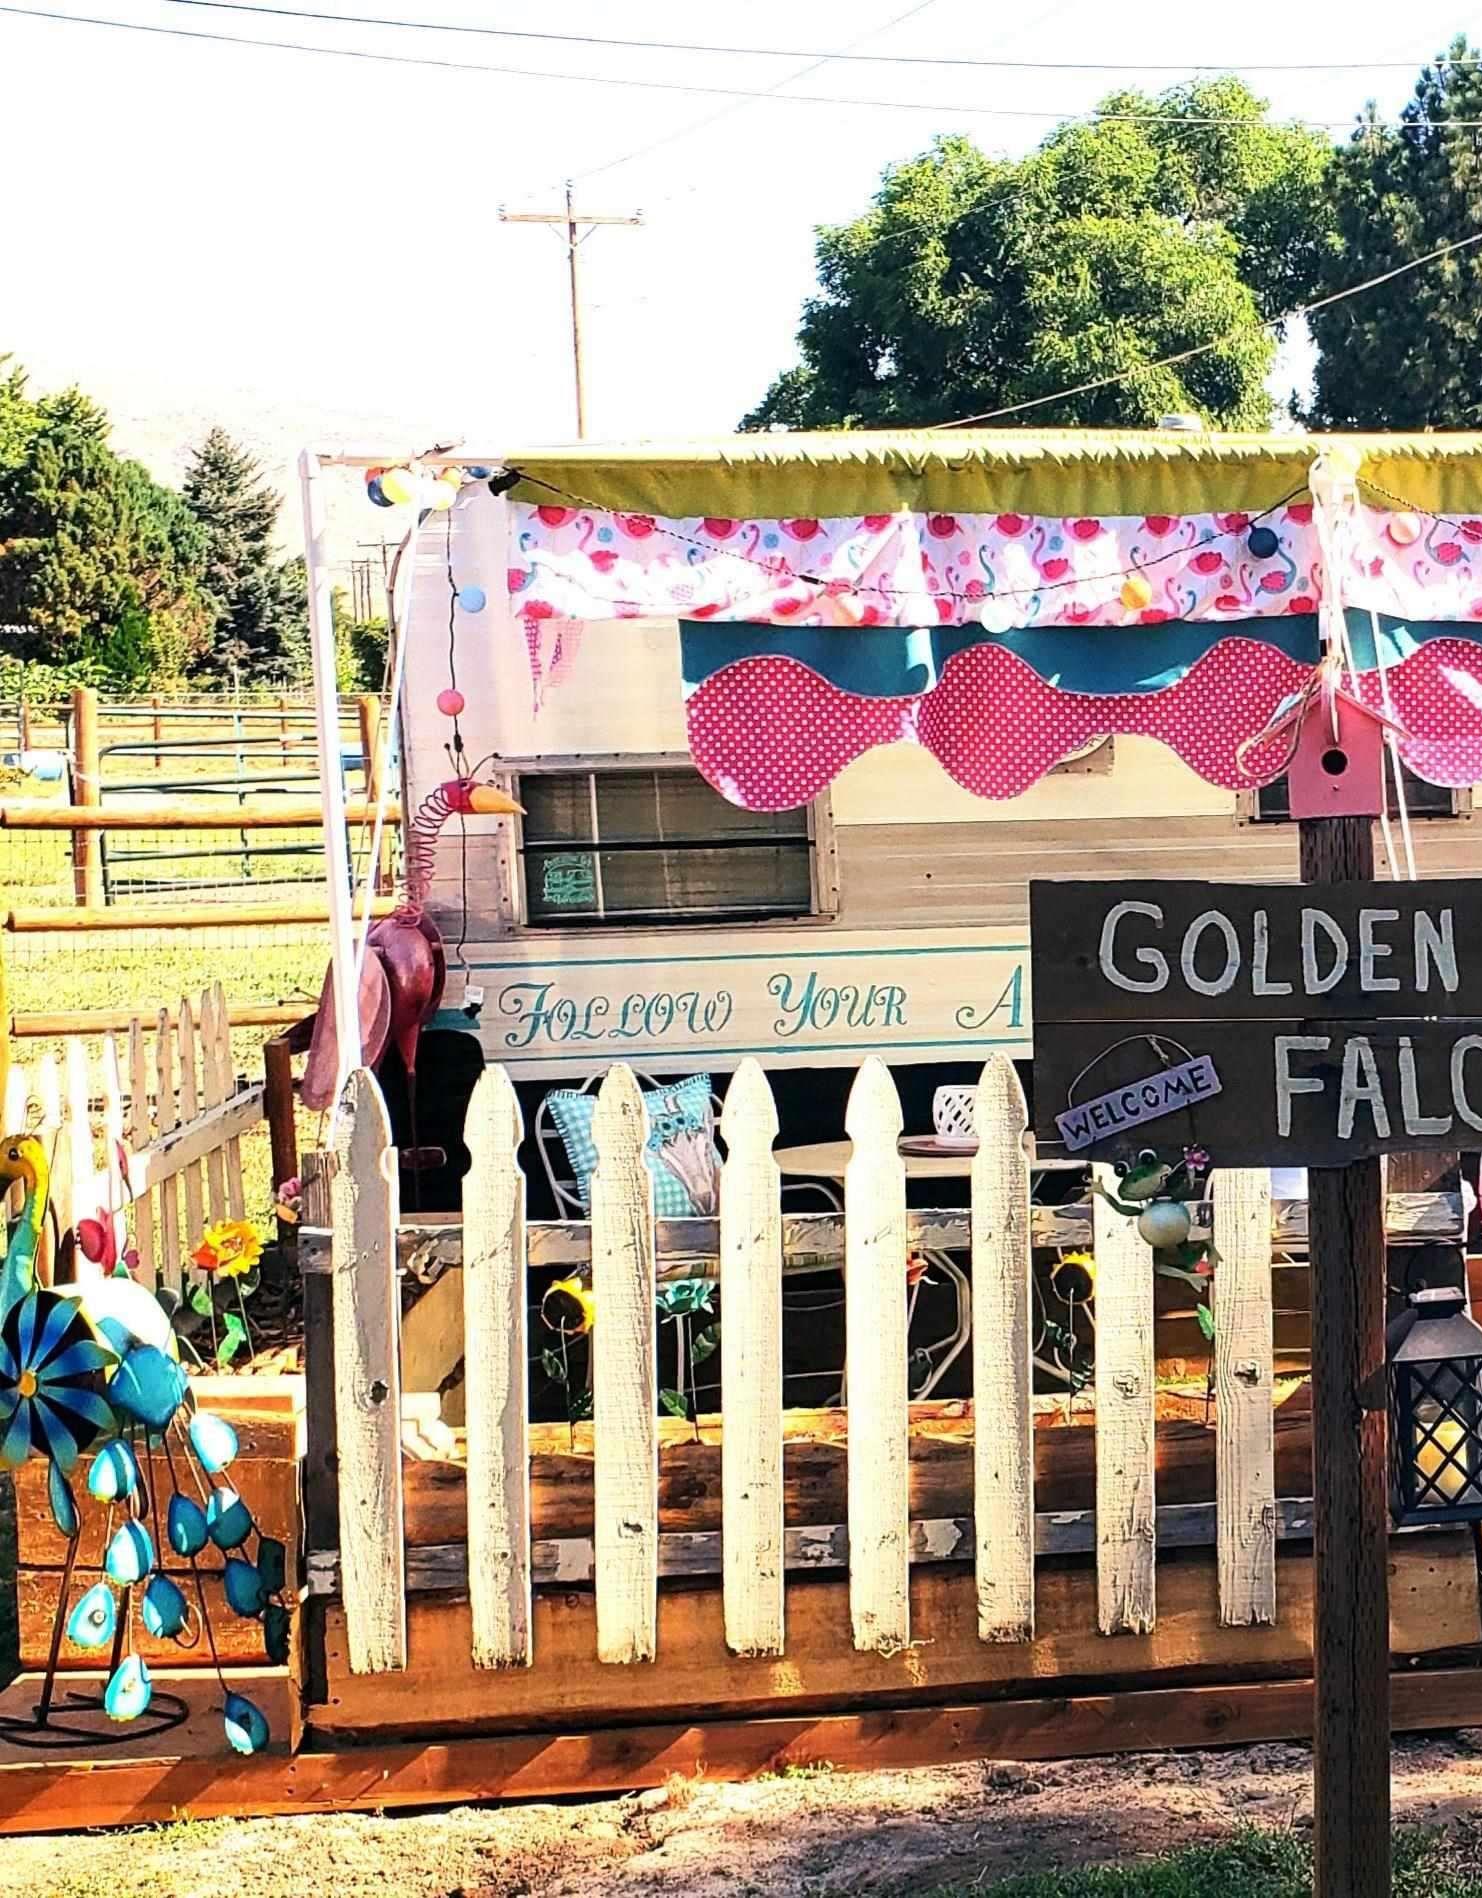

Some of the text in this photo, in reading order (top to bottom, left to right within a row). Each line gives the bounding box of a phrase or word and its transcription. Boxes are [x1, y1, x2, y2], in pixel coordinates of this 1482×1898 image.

[1099, 900, 1459, 997] GOLDEN
[498, 981, 733, 1048] FOLLOW
[766, 971, 908, 1037] YOUR
[1062, 1065, 1212, 1140] WELCOME
